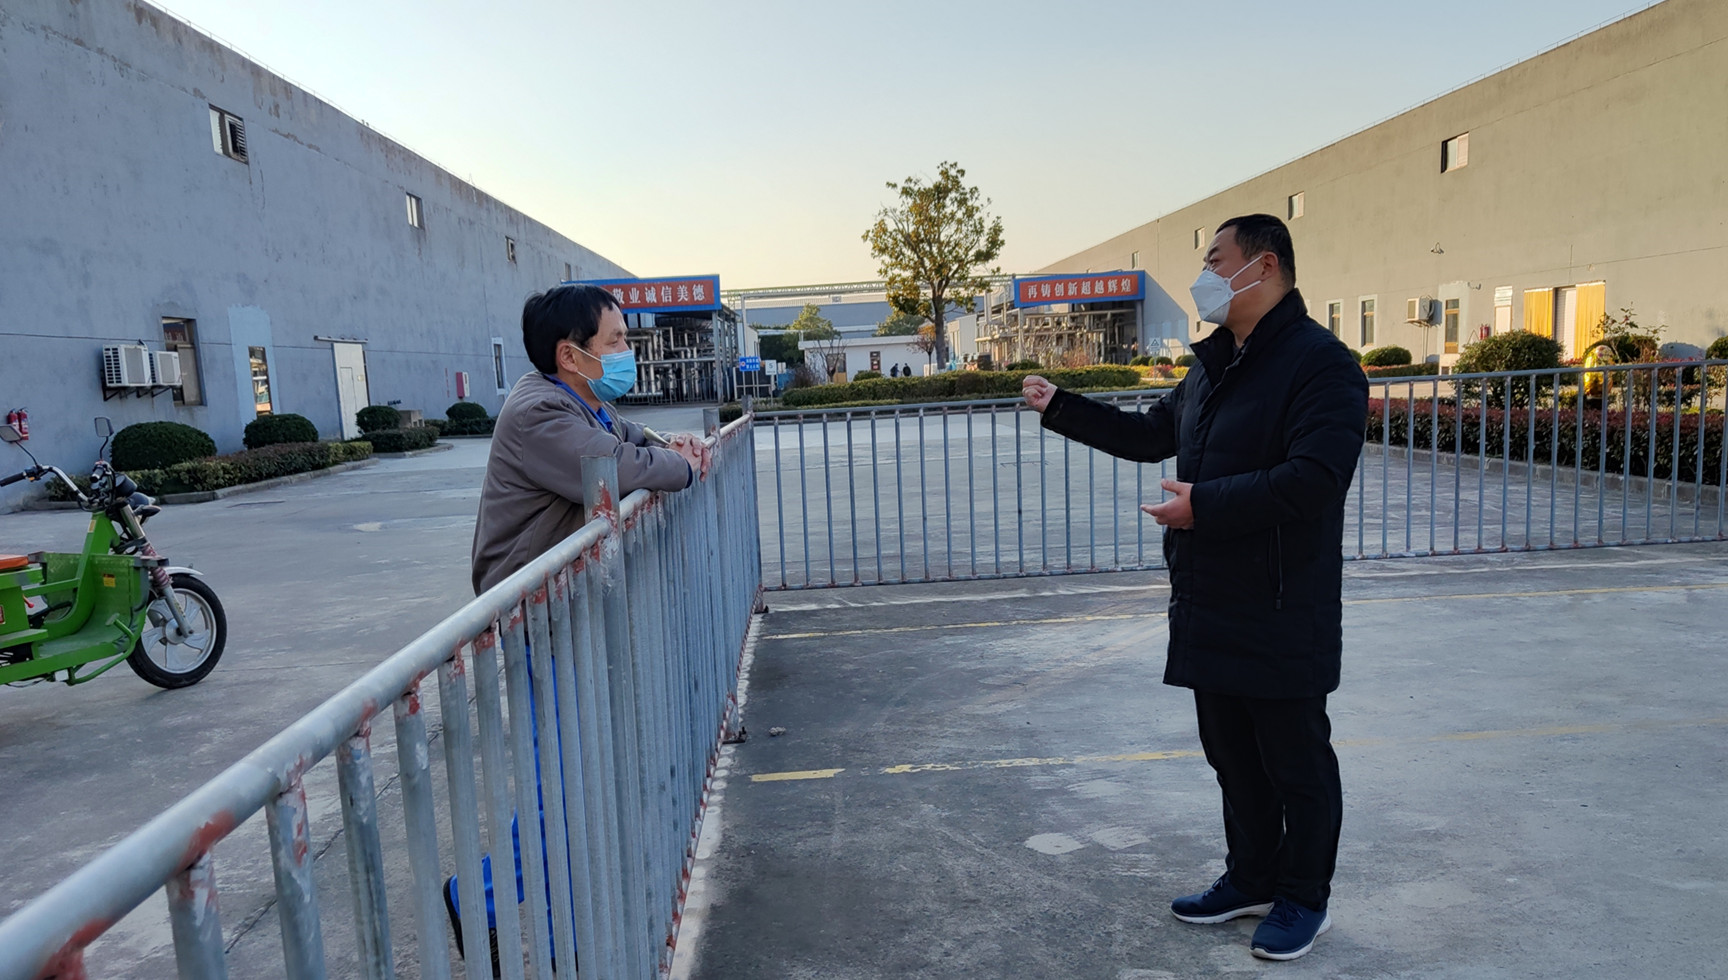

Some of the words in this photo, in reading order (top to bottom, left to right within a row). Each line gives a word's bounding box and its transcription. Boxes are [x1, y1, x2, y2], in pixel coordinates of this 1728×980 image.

[1027, 278, 1132, 299] 再铸创新超越辉煌
